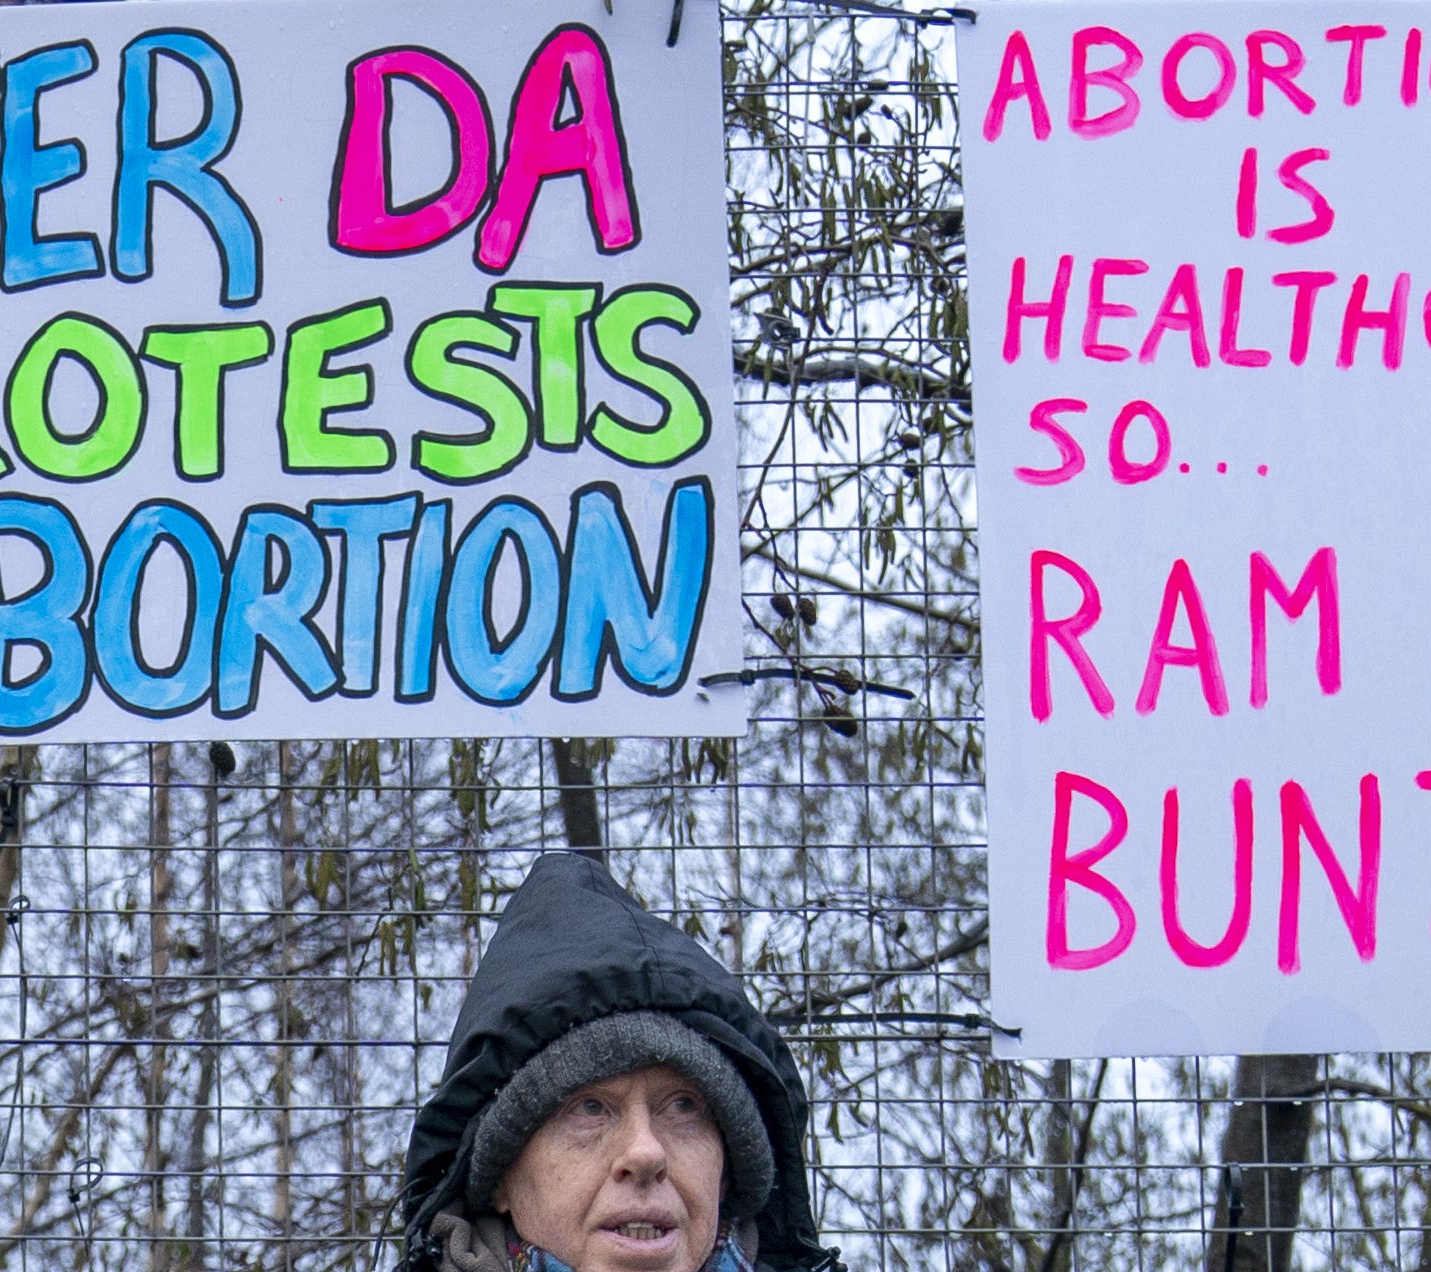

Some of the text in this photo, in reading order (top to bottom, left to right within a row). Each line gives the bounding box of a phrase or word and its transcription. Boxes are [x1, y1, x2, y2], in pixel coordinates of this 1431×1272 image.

[328, 21, 642, 273] DA
[1234, 146, 1337, 246] IS
[1012, 397, 1269, 486] SO...
[1028, 545, 1342, 723] RAM
